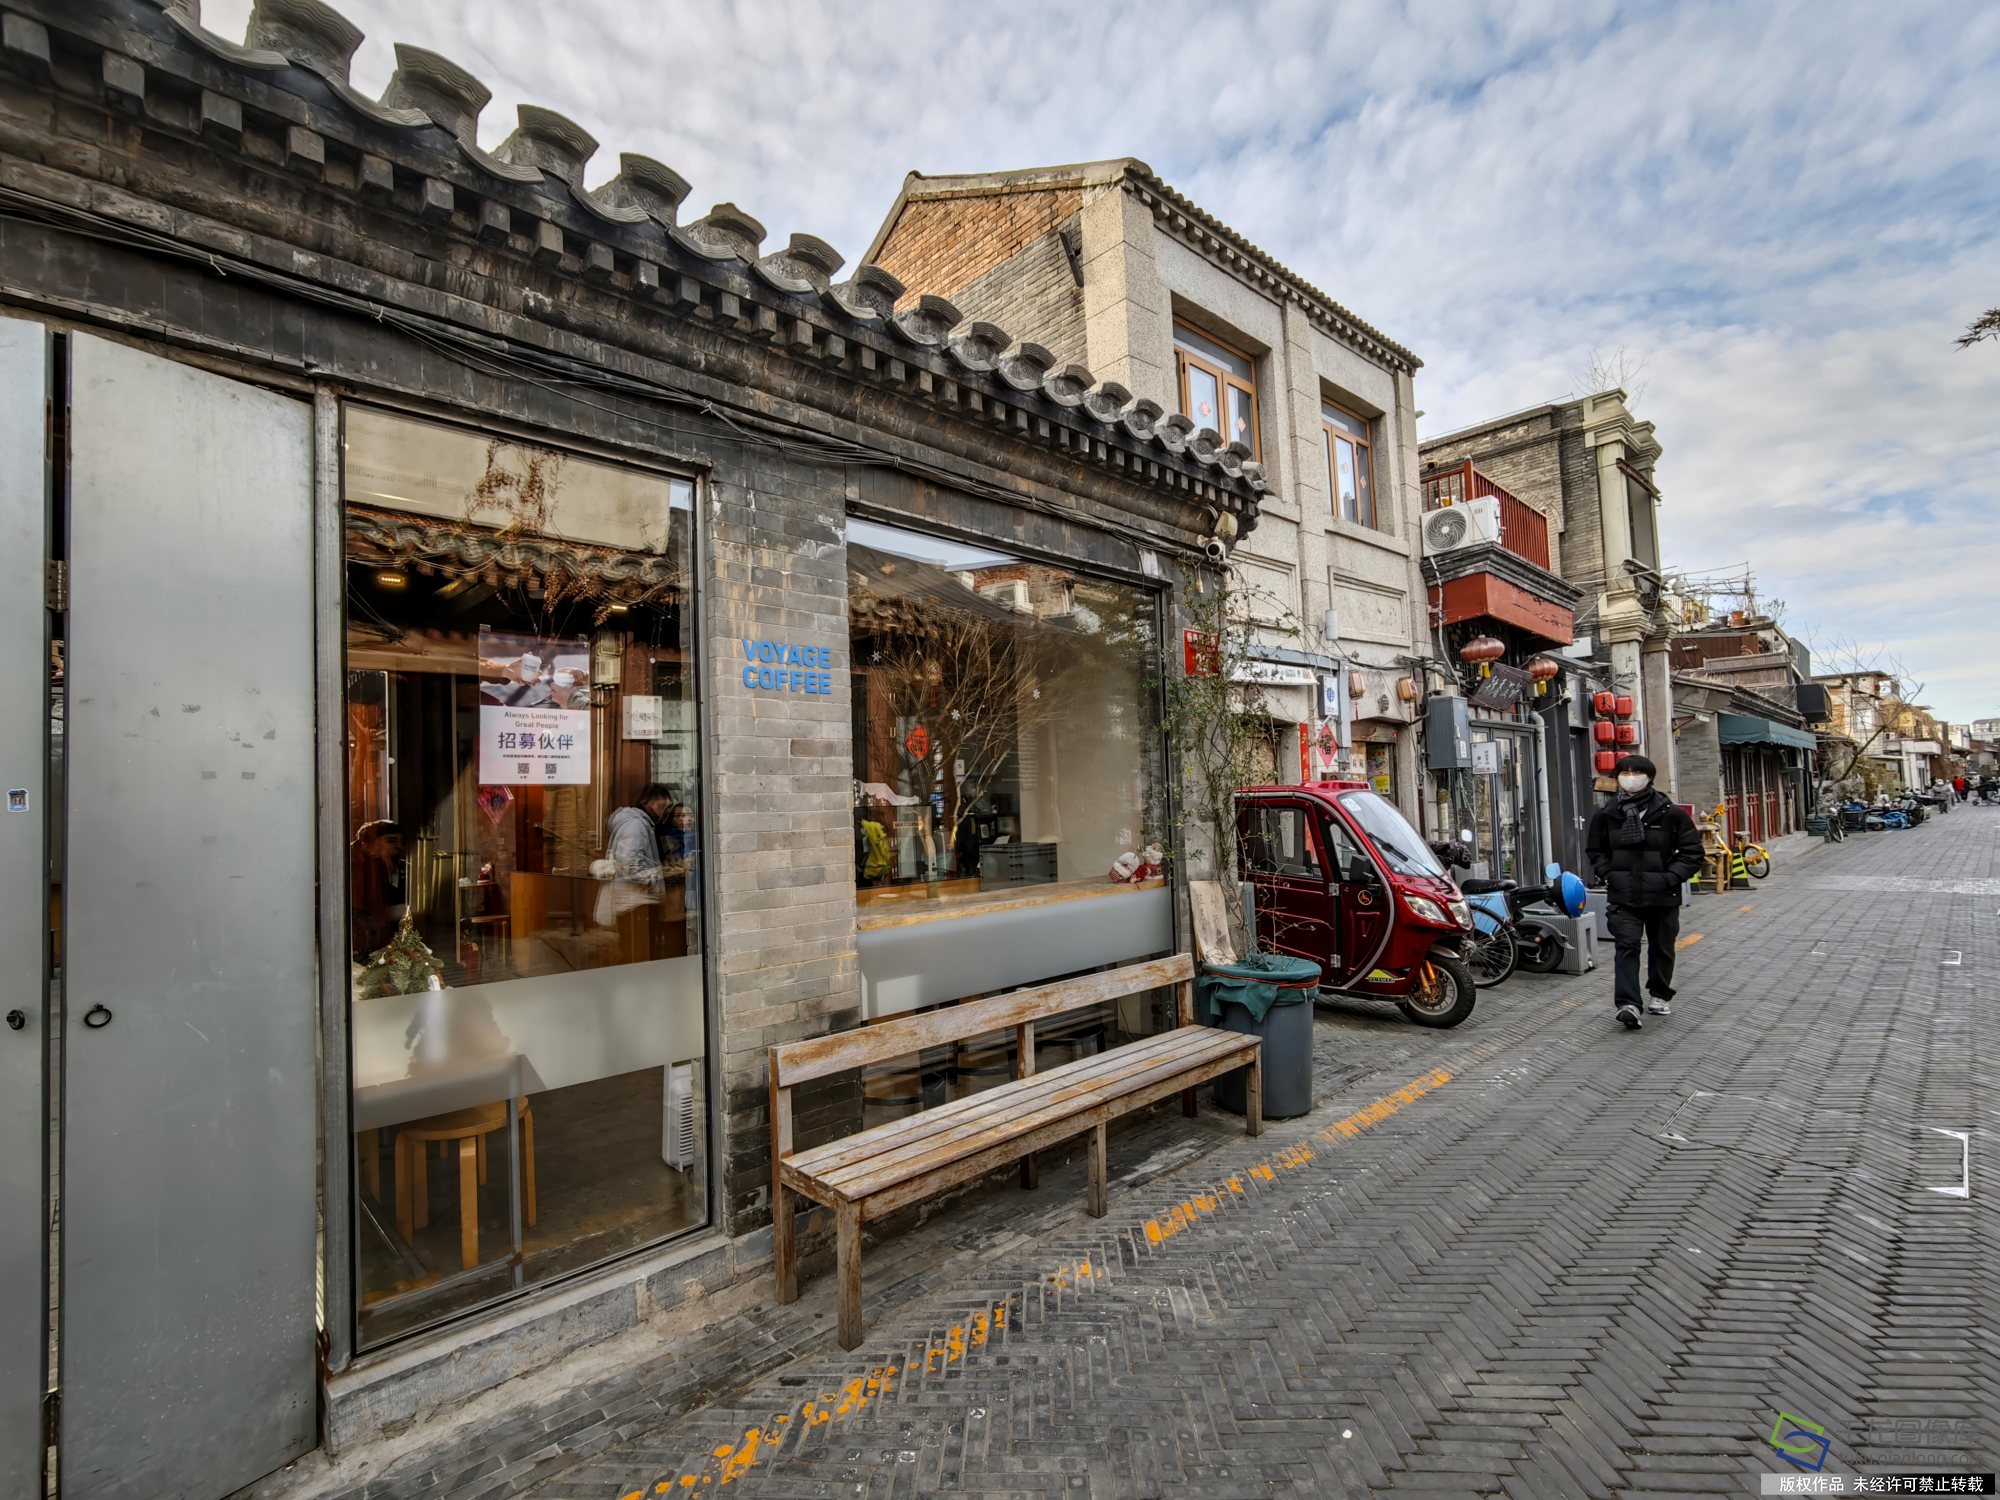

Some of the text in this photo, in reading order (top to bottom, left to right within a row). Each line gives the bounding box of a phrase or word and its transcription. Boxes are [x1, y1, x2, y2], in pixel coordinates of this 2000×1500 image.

[742, 638, 832, 669] VOYAGE
[743, 666, 833, 694] COFFEE
[504, 711, 530, 719] Always
[531, 713, 558, 721] Looking
[498, 732, 574, 750] 招募伙伴
